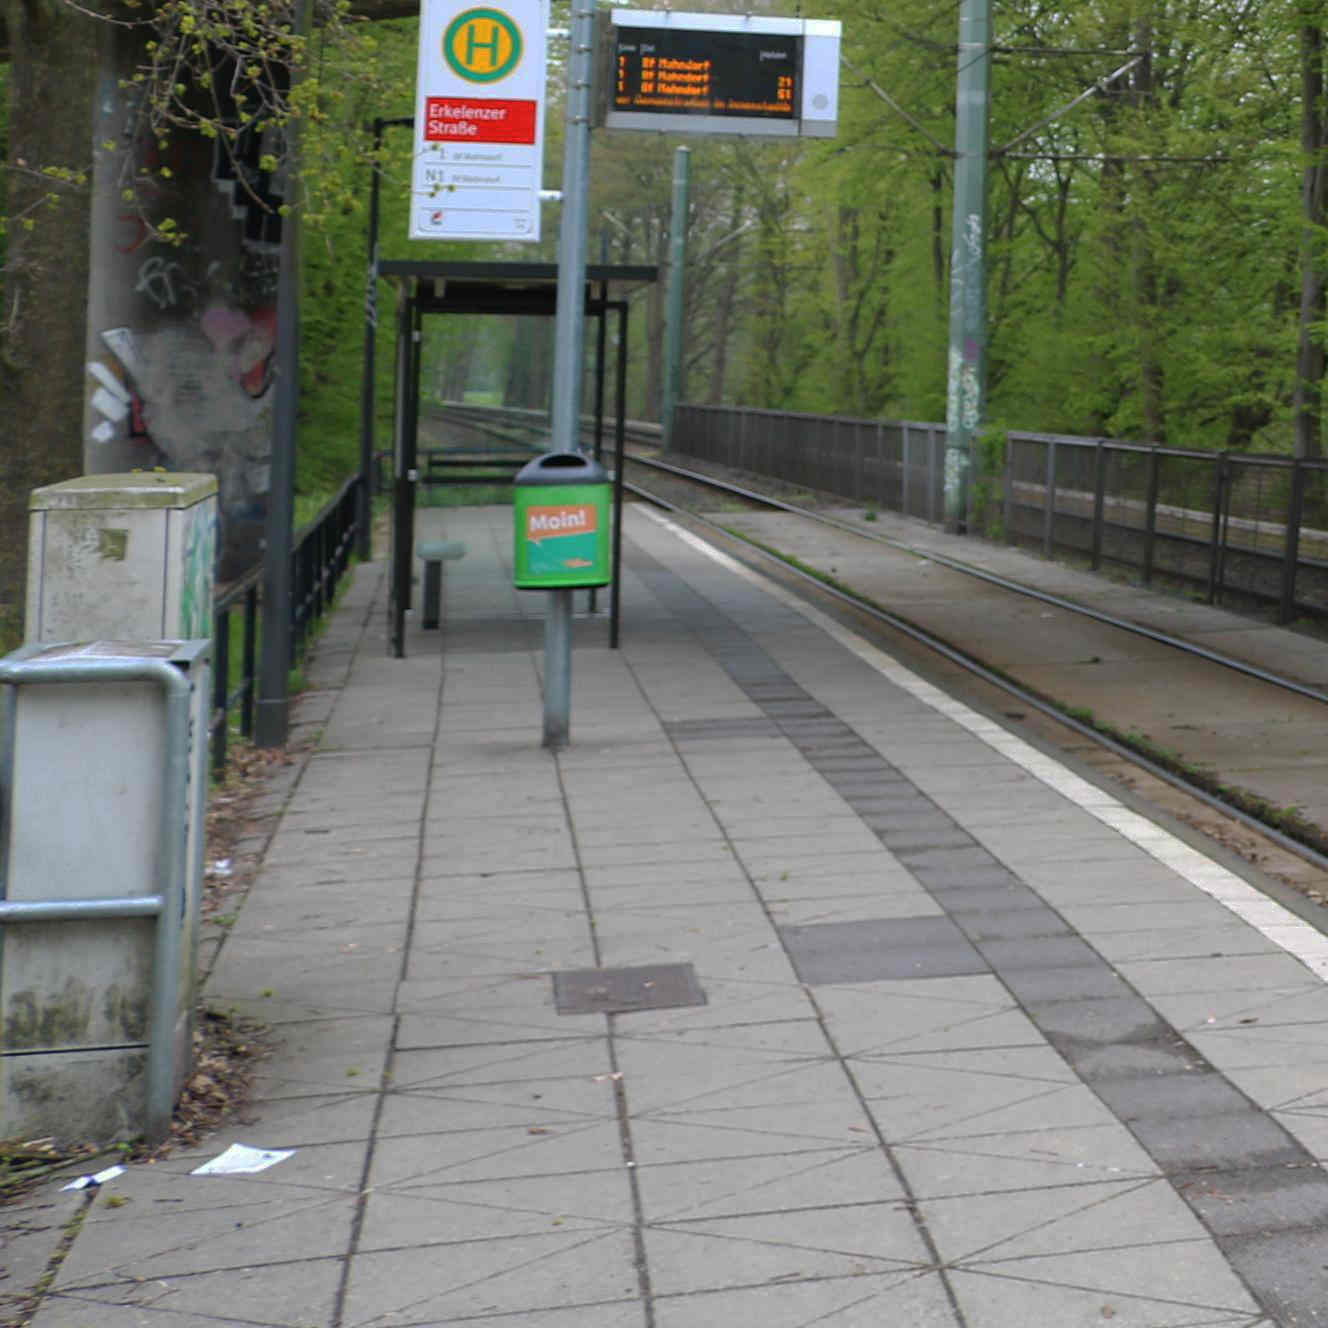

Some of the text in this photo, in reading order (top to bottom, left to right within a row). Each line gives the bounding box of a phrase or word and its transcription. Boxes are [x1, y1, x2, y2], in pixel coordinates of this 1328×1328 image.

[466, 25, 499, 66] H
[429, 103, 507, 120] Erkelenzer
[428, 120, 478, 135] Straße
[530, 509, 586, 531] Moin!
